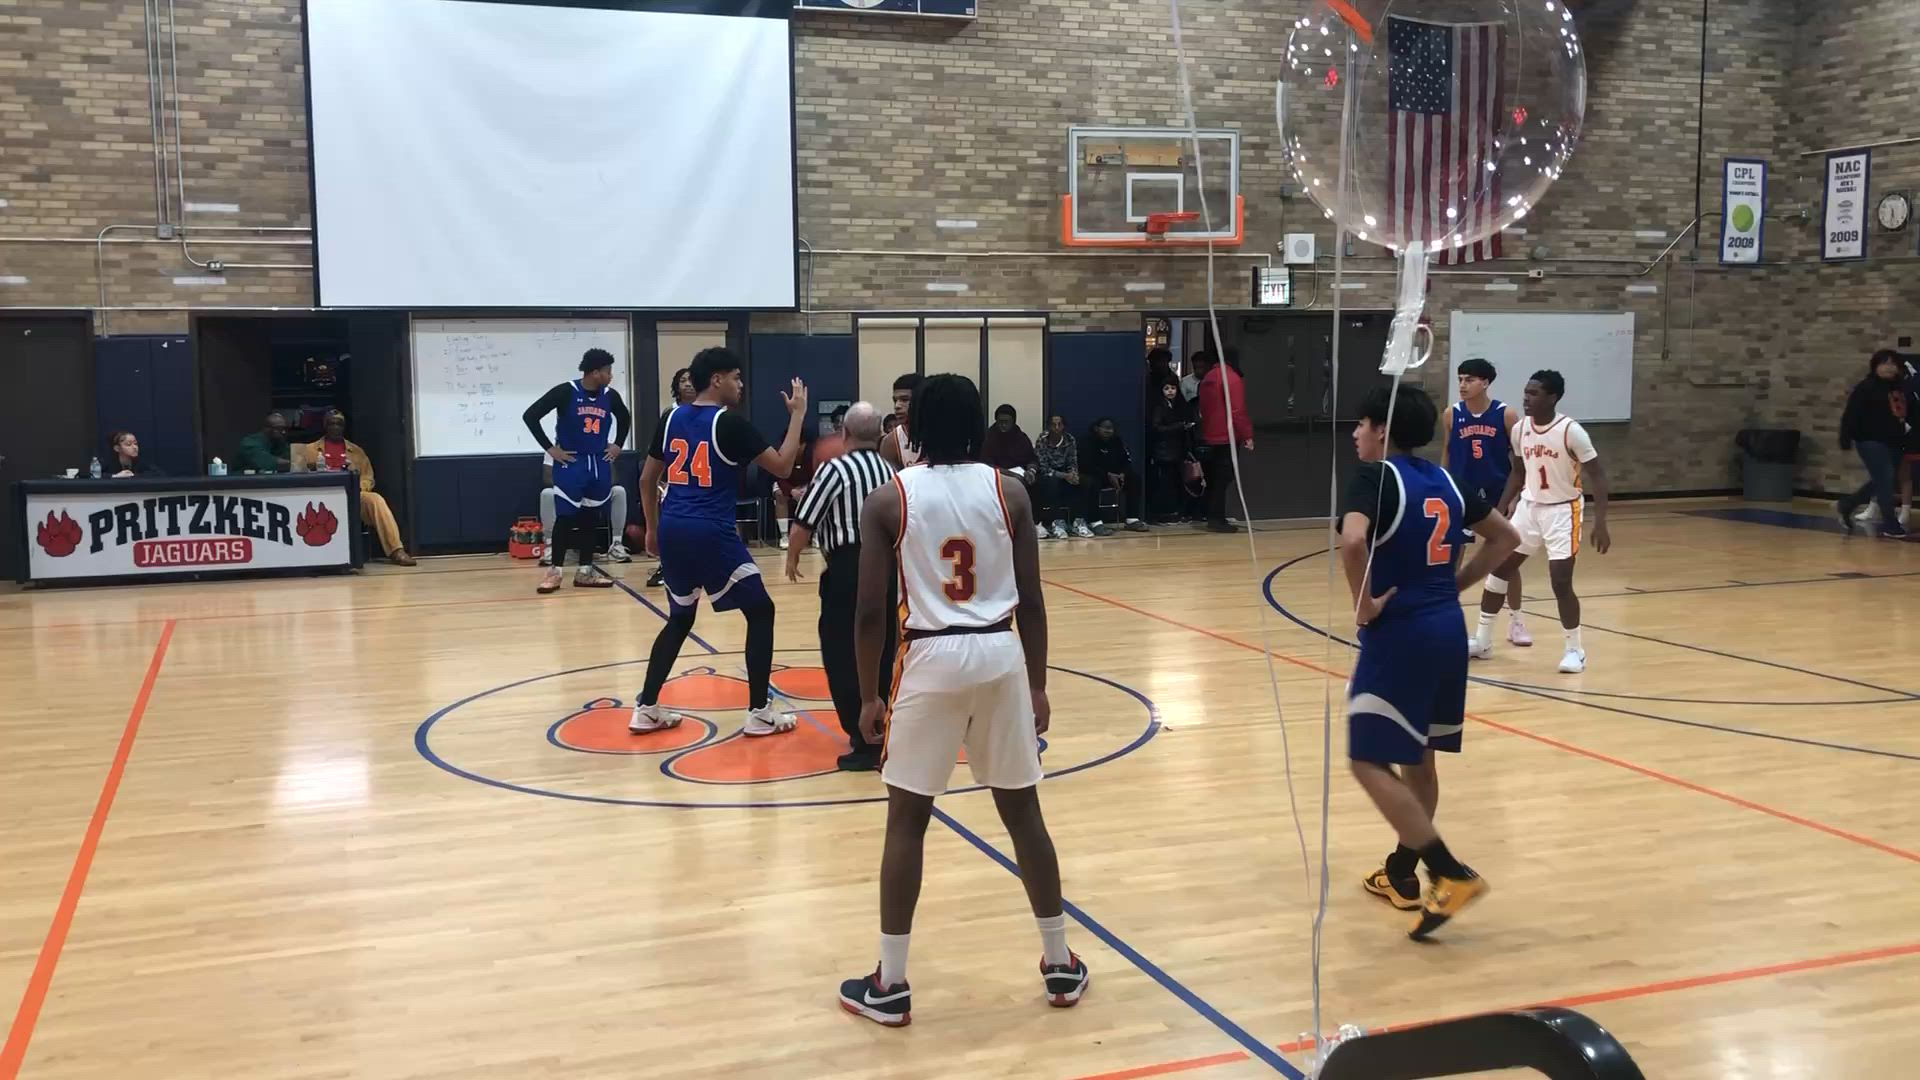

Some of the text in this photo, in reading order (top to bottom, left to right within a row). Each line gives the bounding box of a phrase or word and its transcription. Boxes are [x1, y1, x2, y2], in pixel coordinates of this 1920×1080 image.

[1734, 167, 1755, 180] CPL
[1835, 160, 1861, 173] NAC
[1728, 237, 1755, 249] 2008
[1830, 230, 1859, 243] 2009
[583, 418, 601, 435] 34
[1459, 424, 1497, 439] JAGUARS
[1471, 439, 1483, 459] 5
[1523, 444, 1560, 460] Griffins
[667, 438, 712, 488] 24
[1538, 465, 1550, 490] 1
[89, 495, 293, 553] PRITZKER
[1423, 498, 1452, 566] 2
[141, 541, 245, 565] JAGUARS
[531, 547, 541, 556] G
[940, 535, 977, 604] 3
